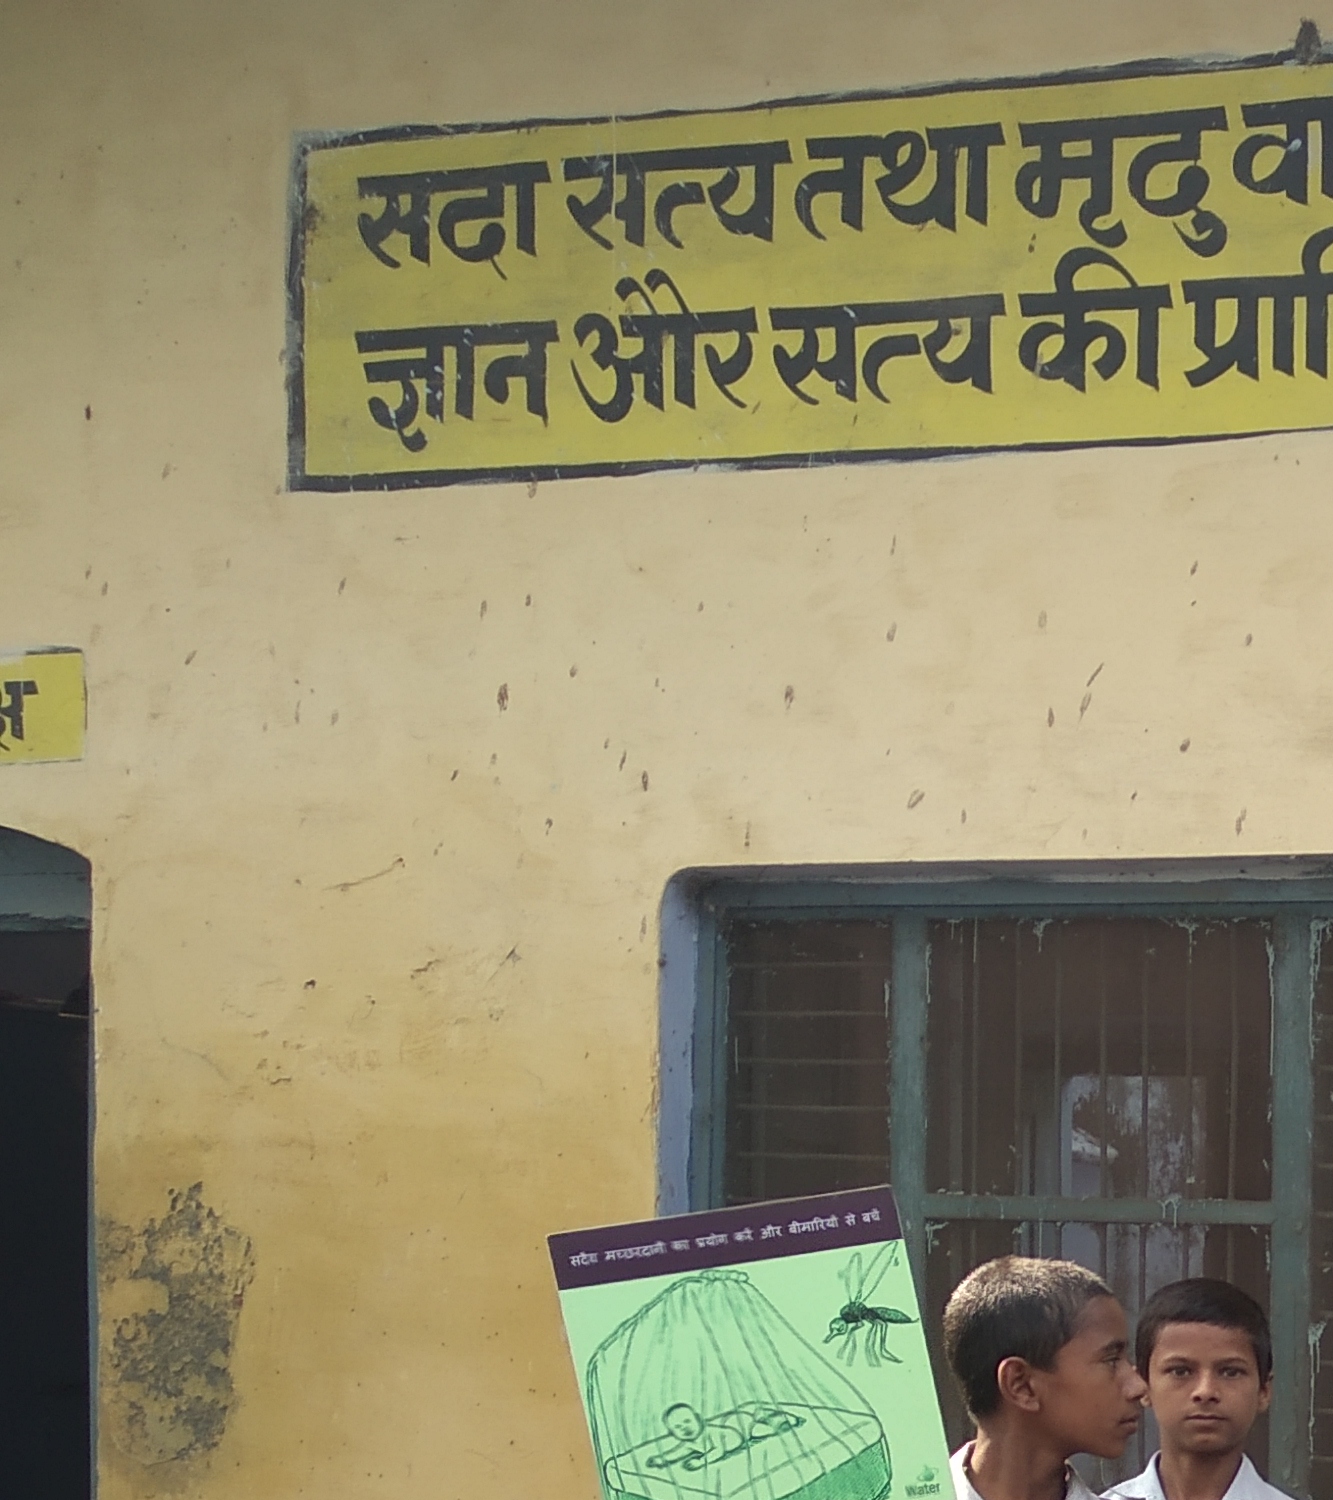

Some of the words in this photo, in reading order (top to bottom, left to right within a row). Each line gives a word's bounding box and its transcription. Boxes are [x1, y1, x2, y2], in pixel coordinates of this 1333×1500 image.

[357, 161, 551, 280] सदा
[563, 141, 792, 251] सत्य
[795, 123, 1004, 240] तथा
[1015, 106, 1227, 257] मृदु
[355, 320, 559, 453] ज्ञान
[570, 268, 759, 423] और
[769, 293, 1005, 404] सत्य
[1018, 247, 1174, 394] की
[760, 1225, 782, 1239] और
[845, 1213, 856, 1226] से
[905, 1482, 940, 1497] Water
